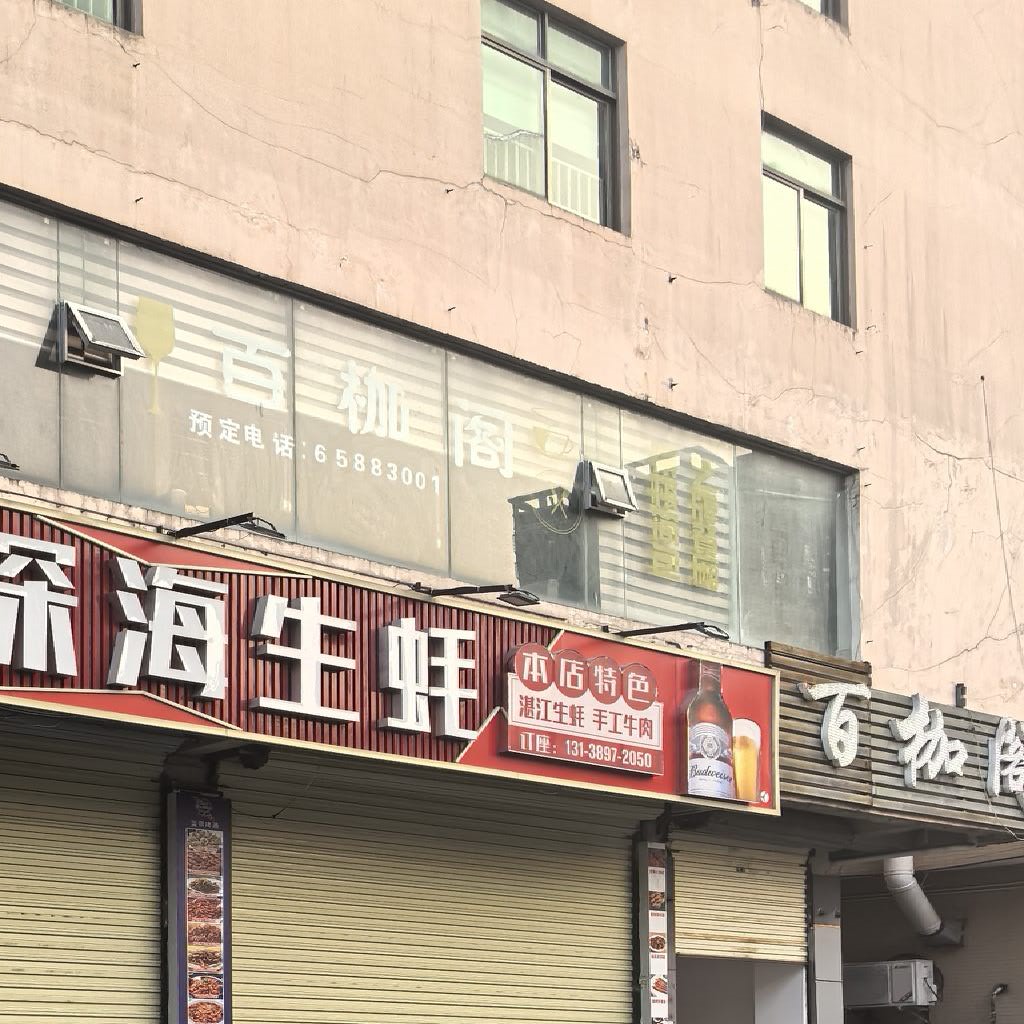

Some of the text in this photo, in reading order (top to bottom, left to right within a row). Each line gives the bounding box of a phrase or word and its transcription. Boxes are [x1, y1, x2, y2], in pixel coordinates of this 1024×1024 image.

[522, 652, 650, 704] 本店特色
[519, 694, 653, 740] 湛江生蚝 手工牛肉
[565, 739, 652, 769] 131-3897-2050
